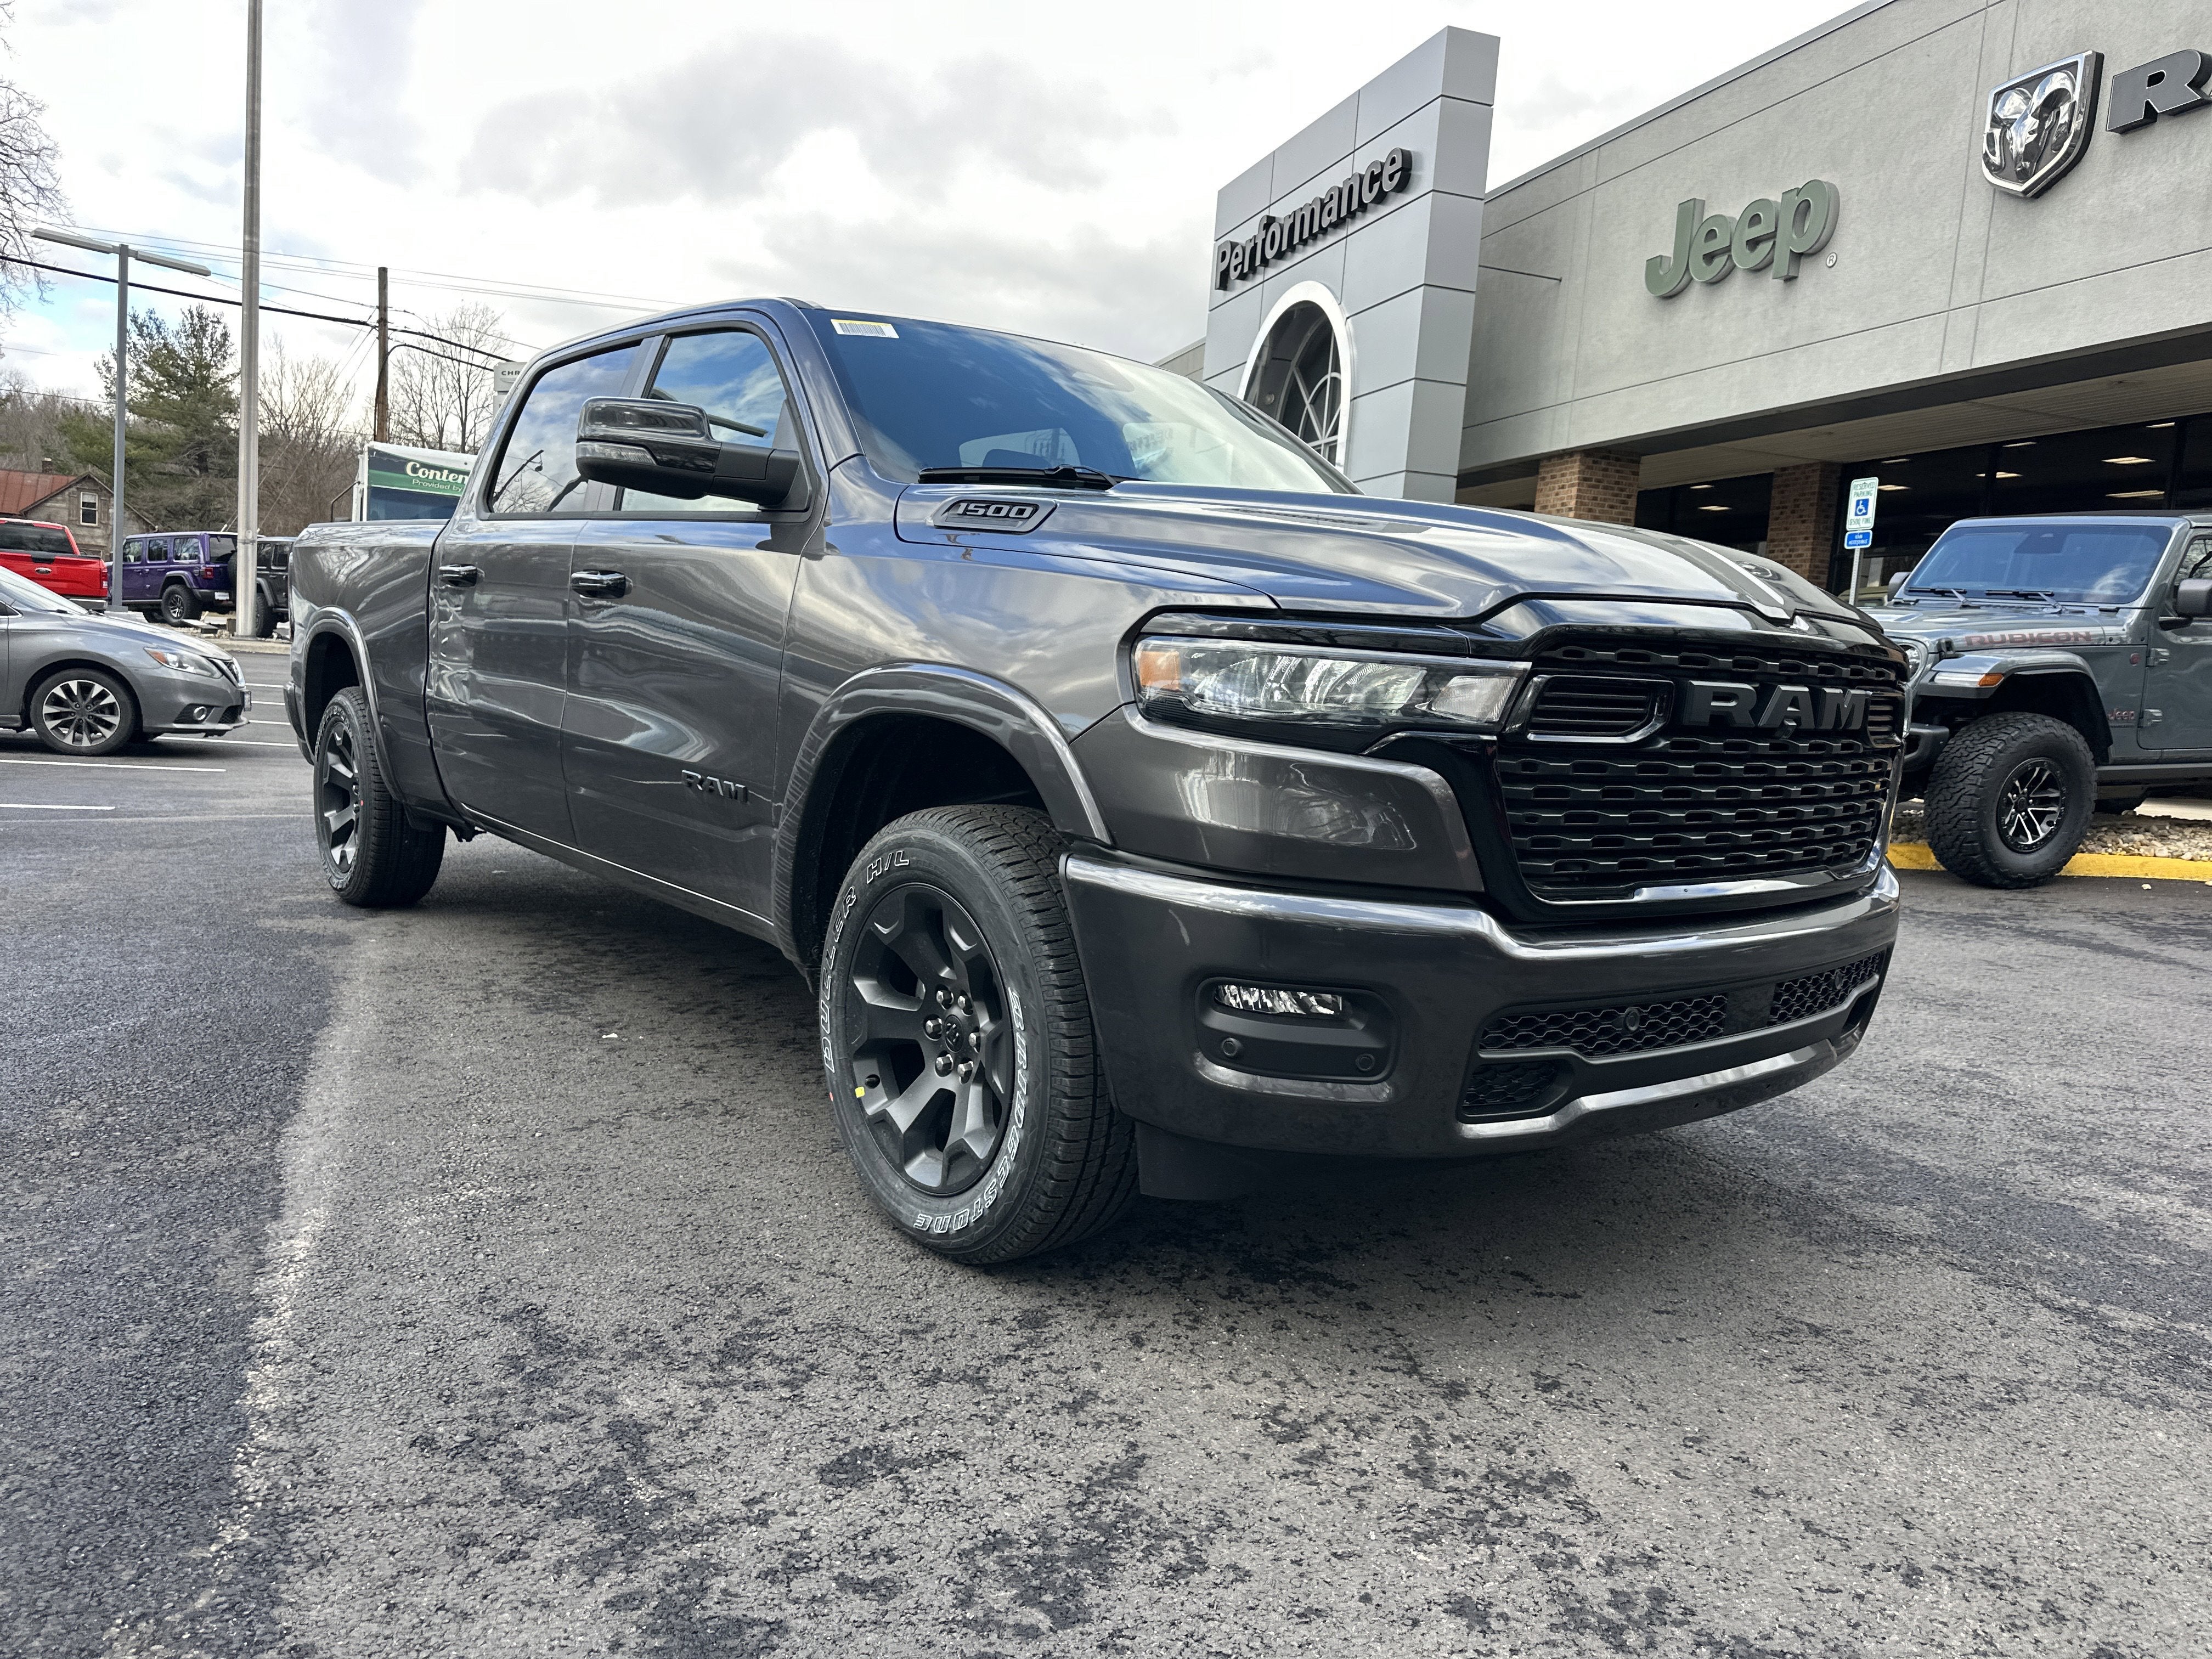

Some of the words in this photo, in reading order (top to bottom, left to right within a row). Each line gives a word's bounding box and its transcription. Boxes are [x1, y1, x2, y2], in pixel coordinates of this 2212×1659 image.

[2106, 48, 2212, 135] R
[1215, 147, 1413, 290] Performance
[1645, 179, 1840, 297] Jeep
[412, 478, 450, 490] Provided
[1853, 482, 1875, 491] RESERVED
[1853, 489, 1873, 498] PARKING
[957, 503, 1034, 518] 1500
[1965, 631, 2091, 646] RUBICON
[1683, 680, 1872, 730] RAM
[682, 770, 749, 804] RAM
[821, 885, 857, 1073] DUELER
[867, 850, 910, 884] H/L
[913, 987, 1028, 1233] BRIDGESTONE
